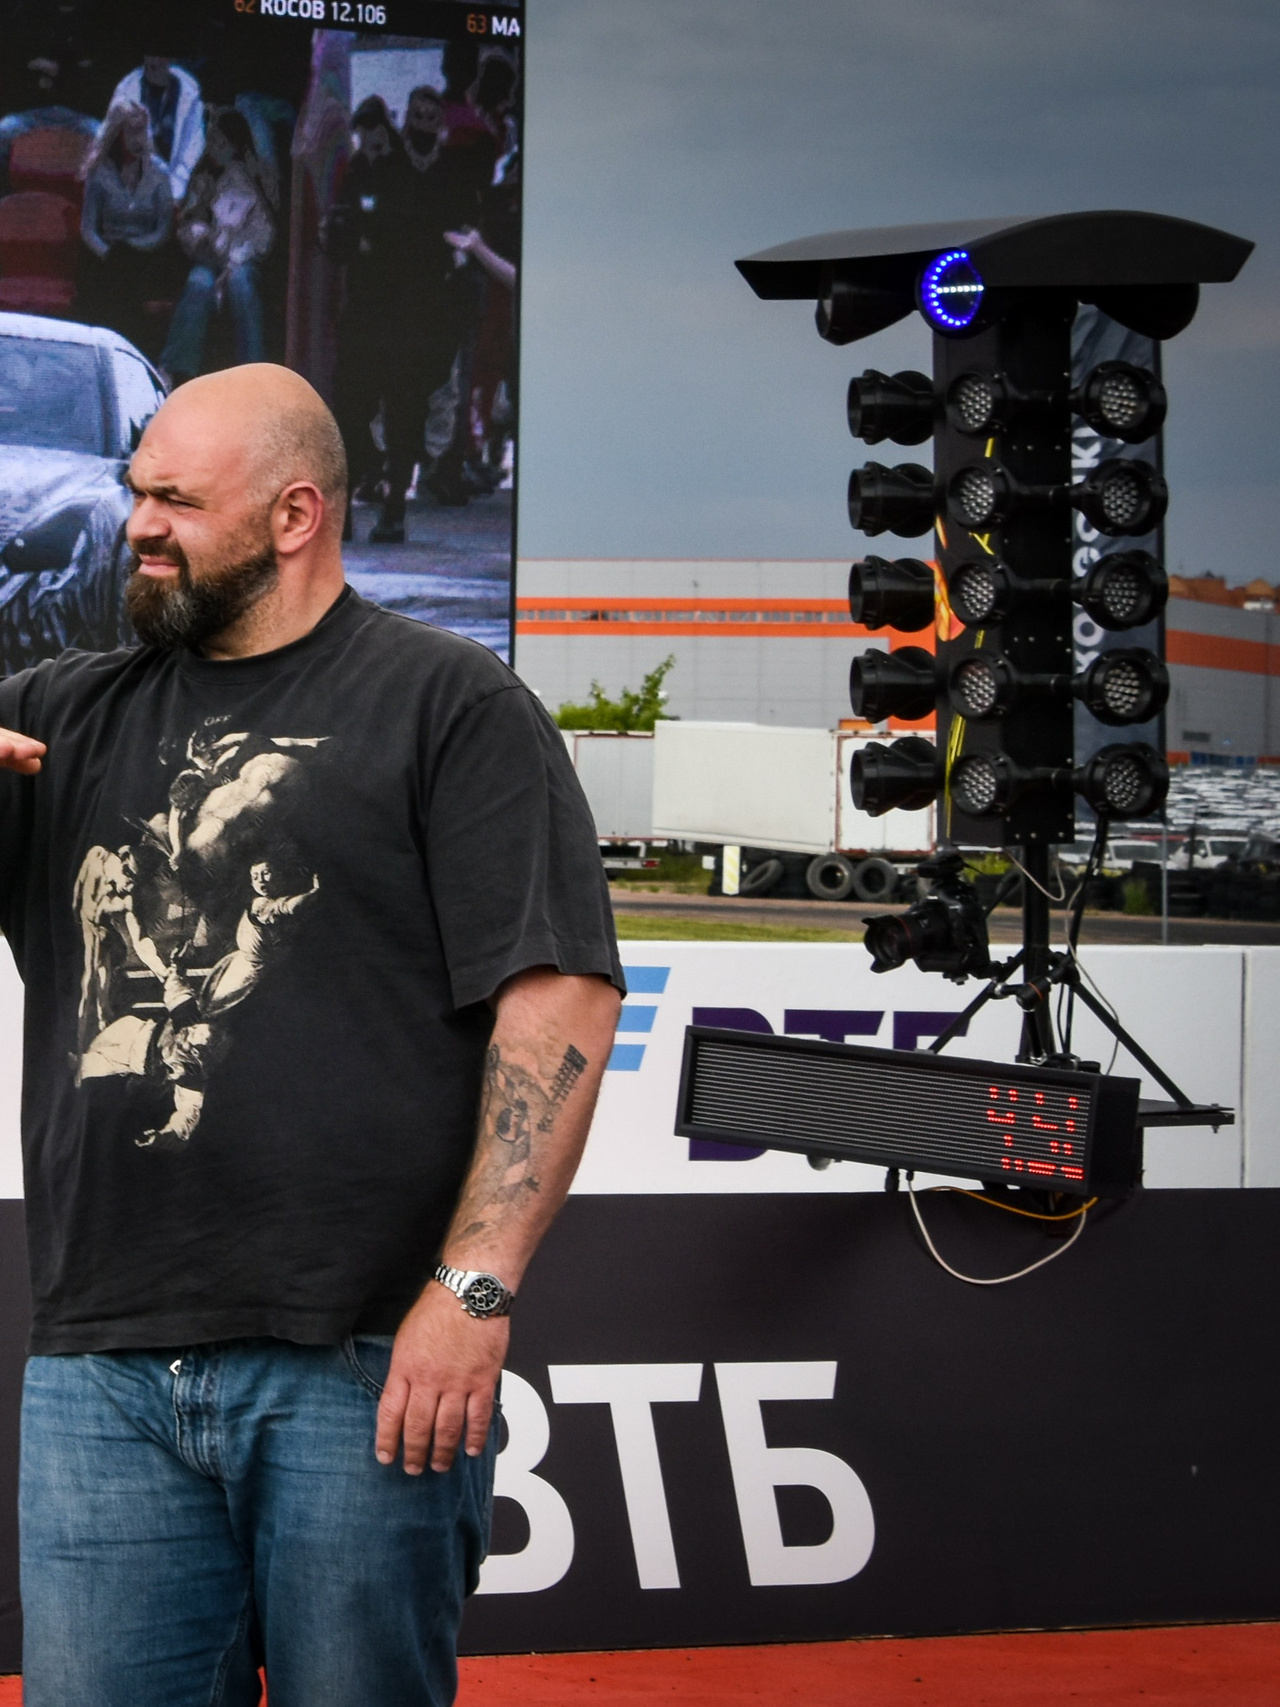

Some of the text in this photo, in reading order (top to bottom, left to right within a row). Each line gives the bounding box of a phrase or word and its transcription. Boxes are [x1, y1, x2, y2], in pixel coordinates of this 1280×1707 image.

[331, 2, 387, 24] 12.106
[467, 13, 487, 33] 63
[473, 1361, 875, 1595] ВТБ
